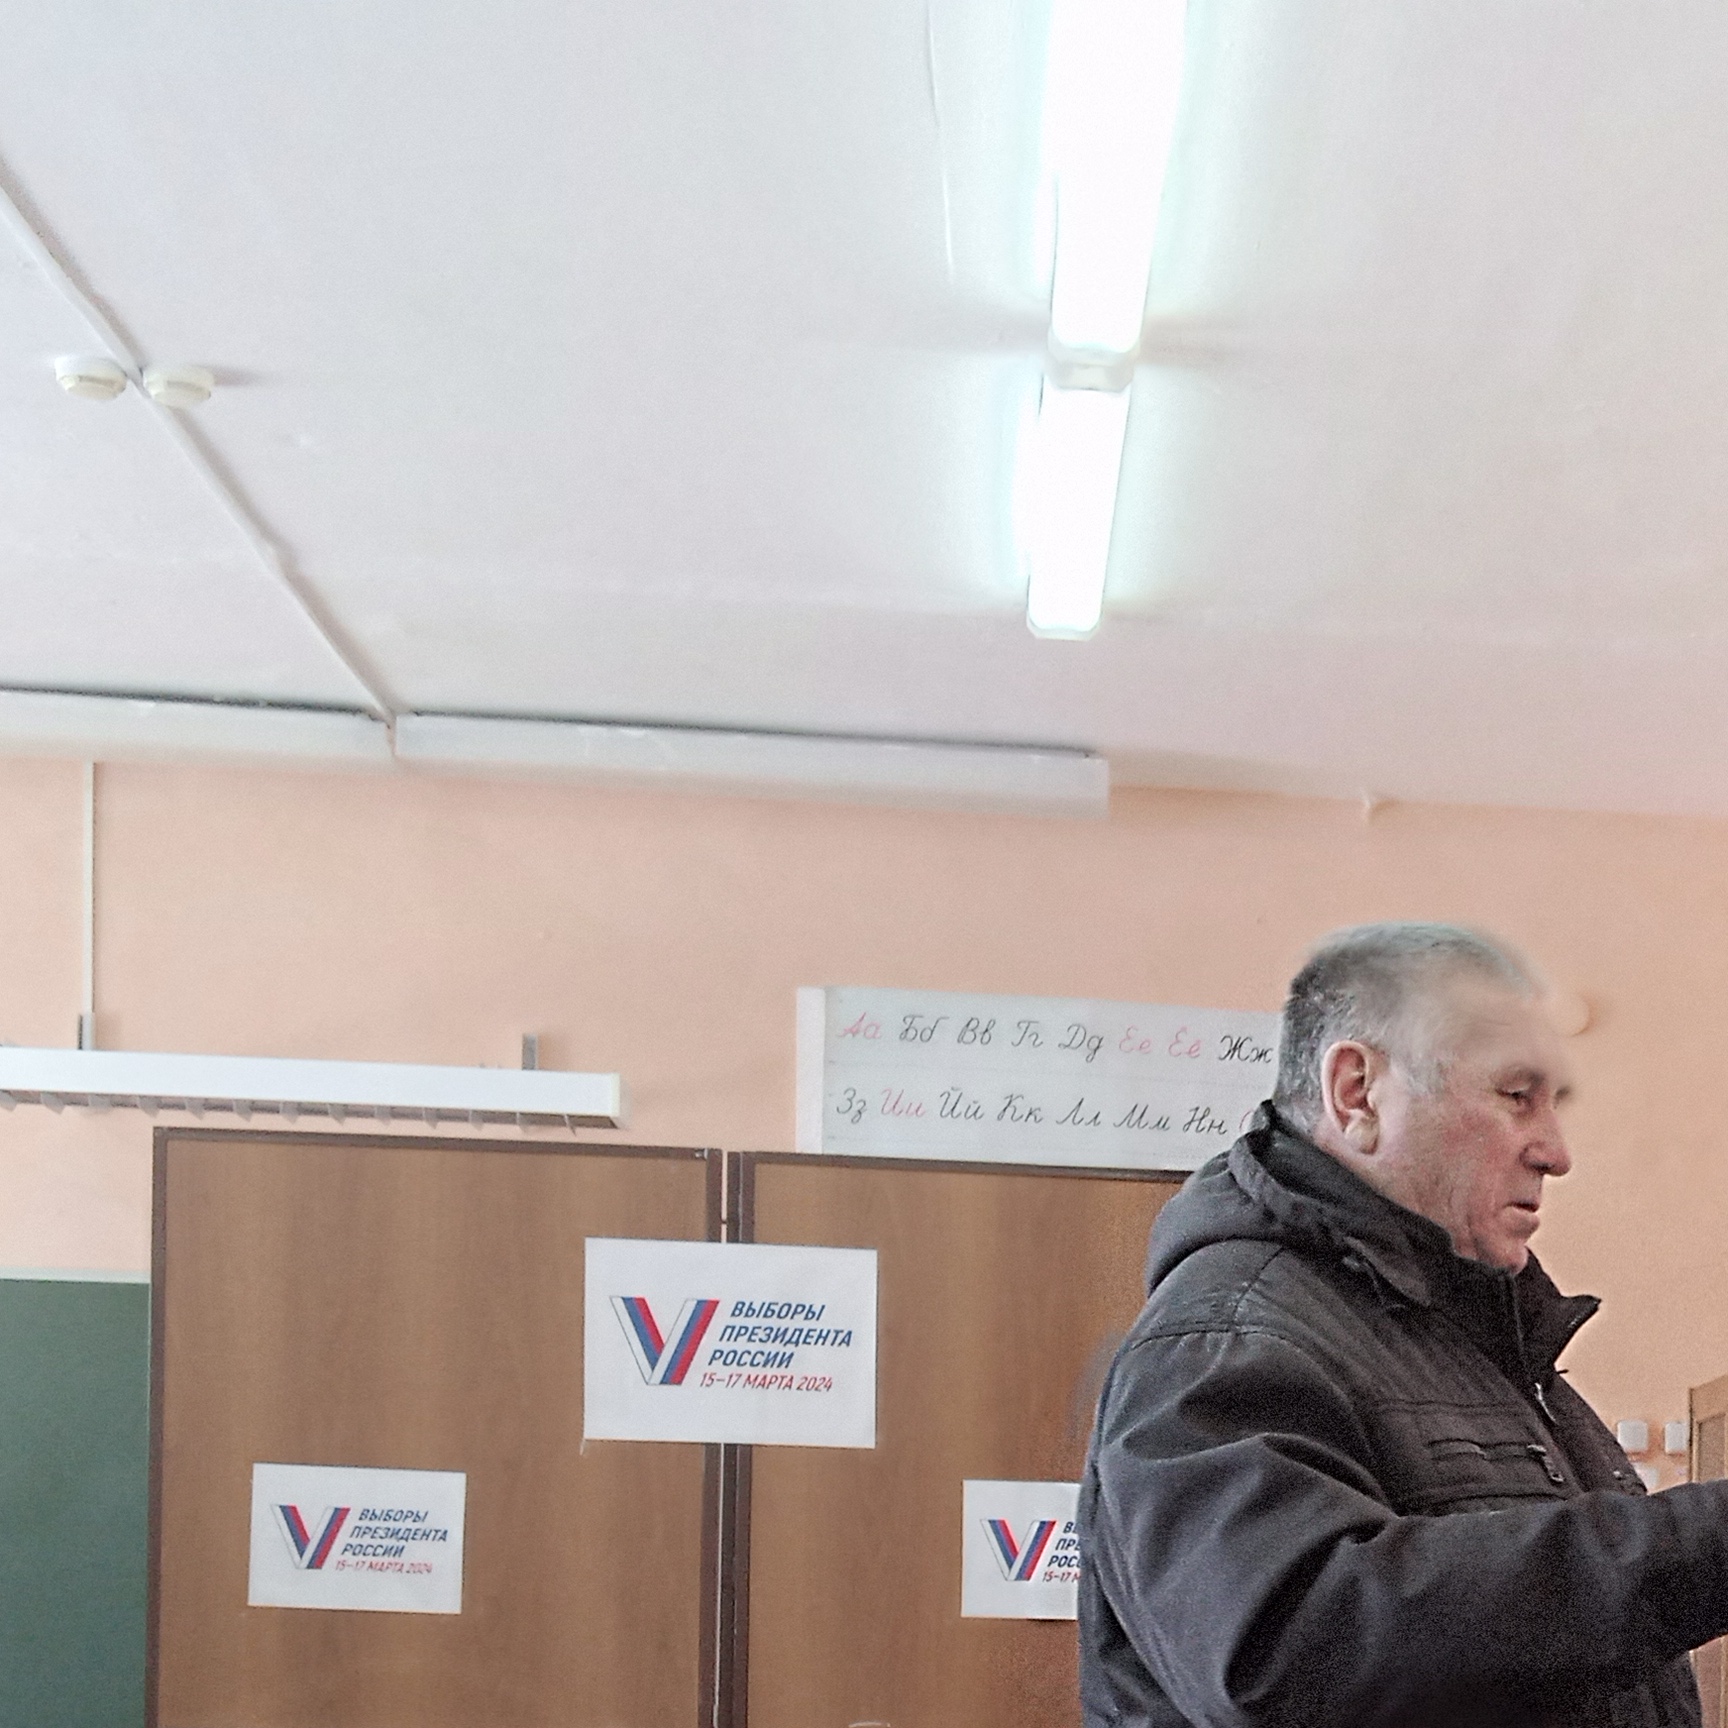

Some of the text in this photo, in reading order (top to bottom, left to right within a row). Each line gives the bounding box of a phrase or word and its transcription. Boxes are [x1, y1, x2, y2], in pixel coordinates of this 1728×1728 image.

[899, 1013, 949, 1045] Бб
[956, 1016, 993, 1047] Вв
[1011, 1018, 1044, 1049] Гг
[1218, 1034, 1274, 1065] Жж
[835, 1087, 868, 1125] Зз
[880, 1087, 926, 1118] Ии
[996, 1093, 1045, 1125] Кк
[1055, 1097, 1102, 1128] Лл
[1113, 1102, 1172, 1134] Мм
[1181, 1106, 1228, 1136] Нн
[730, 1301, 825, 1322] ВЫБОРЫ
[719, 1324, 853, 1347] ПРЕЗИДЕНТА
[708, 1349, 794, 1369] РОССИИ
[743, 1373, 794, 1390] МАРТА
[796, 1376, 833, 1392] 2024
[358, 1508, 428, 1523] ВЫБОРЫ
[350, 1525, 448, 1542] ПРЕЗИДЕНТА
[341, 1543, 405, 1558] РОССИИ
[367, 1561, 403, 1574] МАРТА
[405, 1562, 433, 1574] 2024
